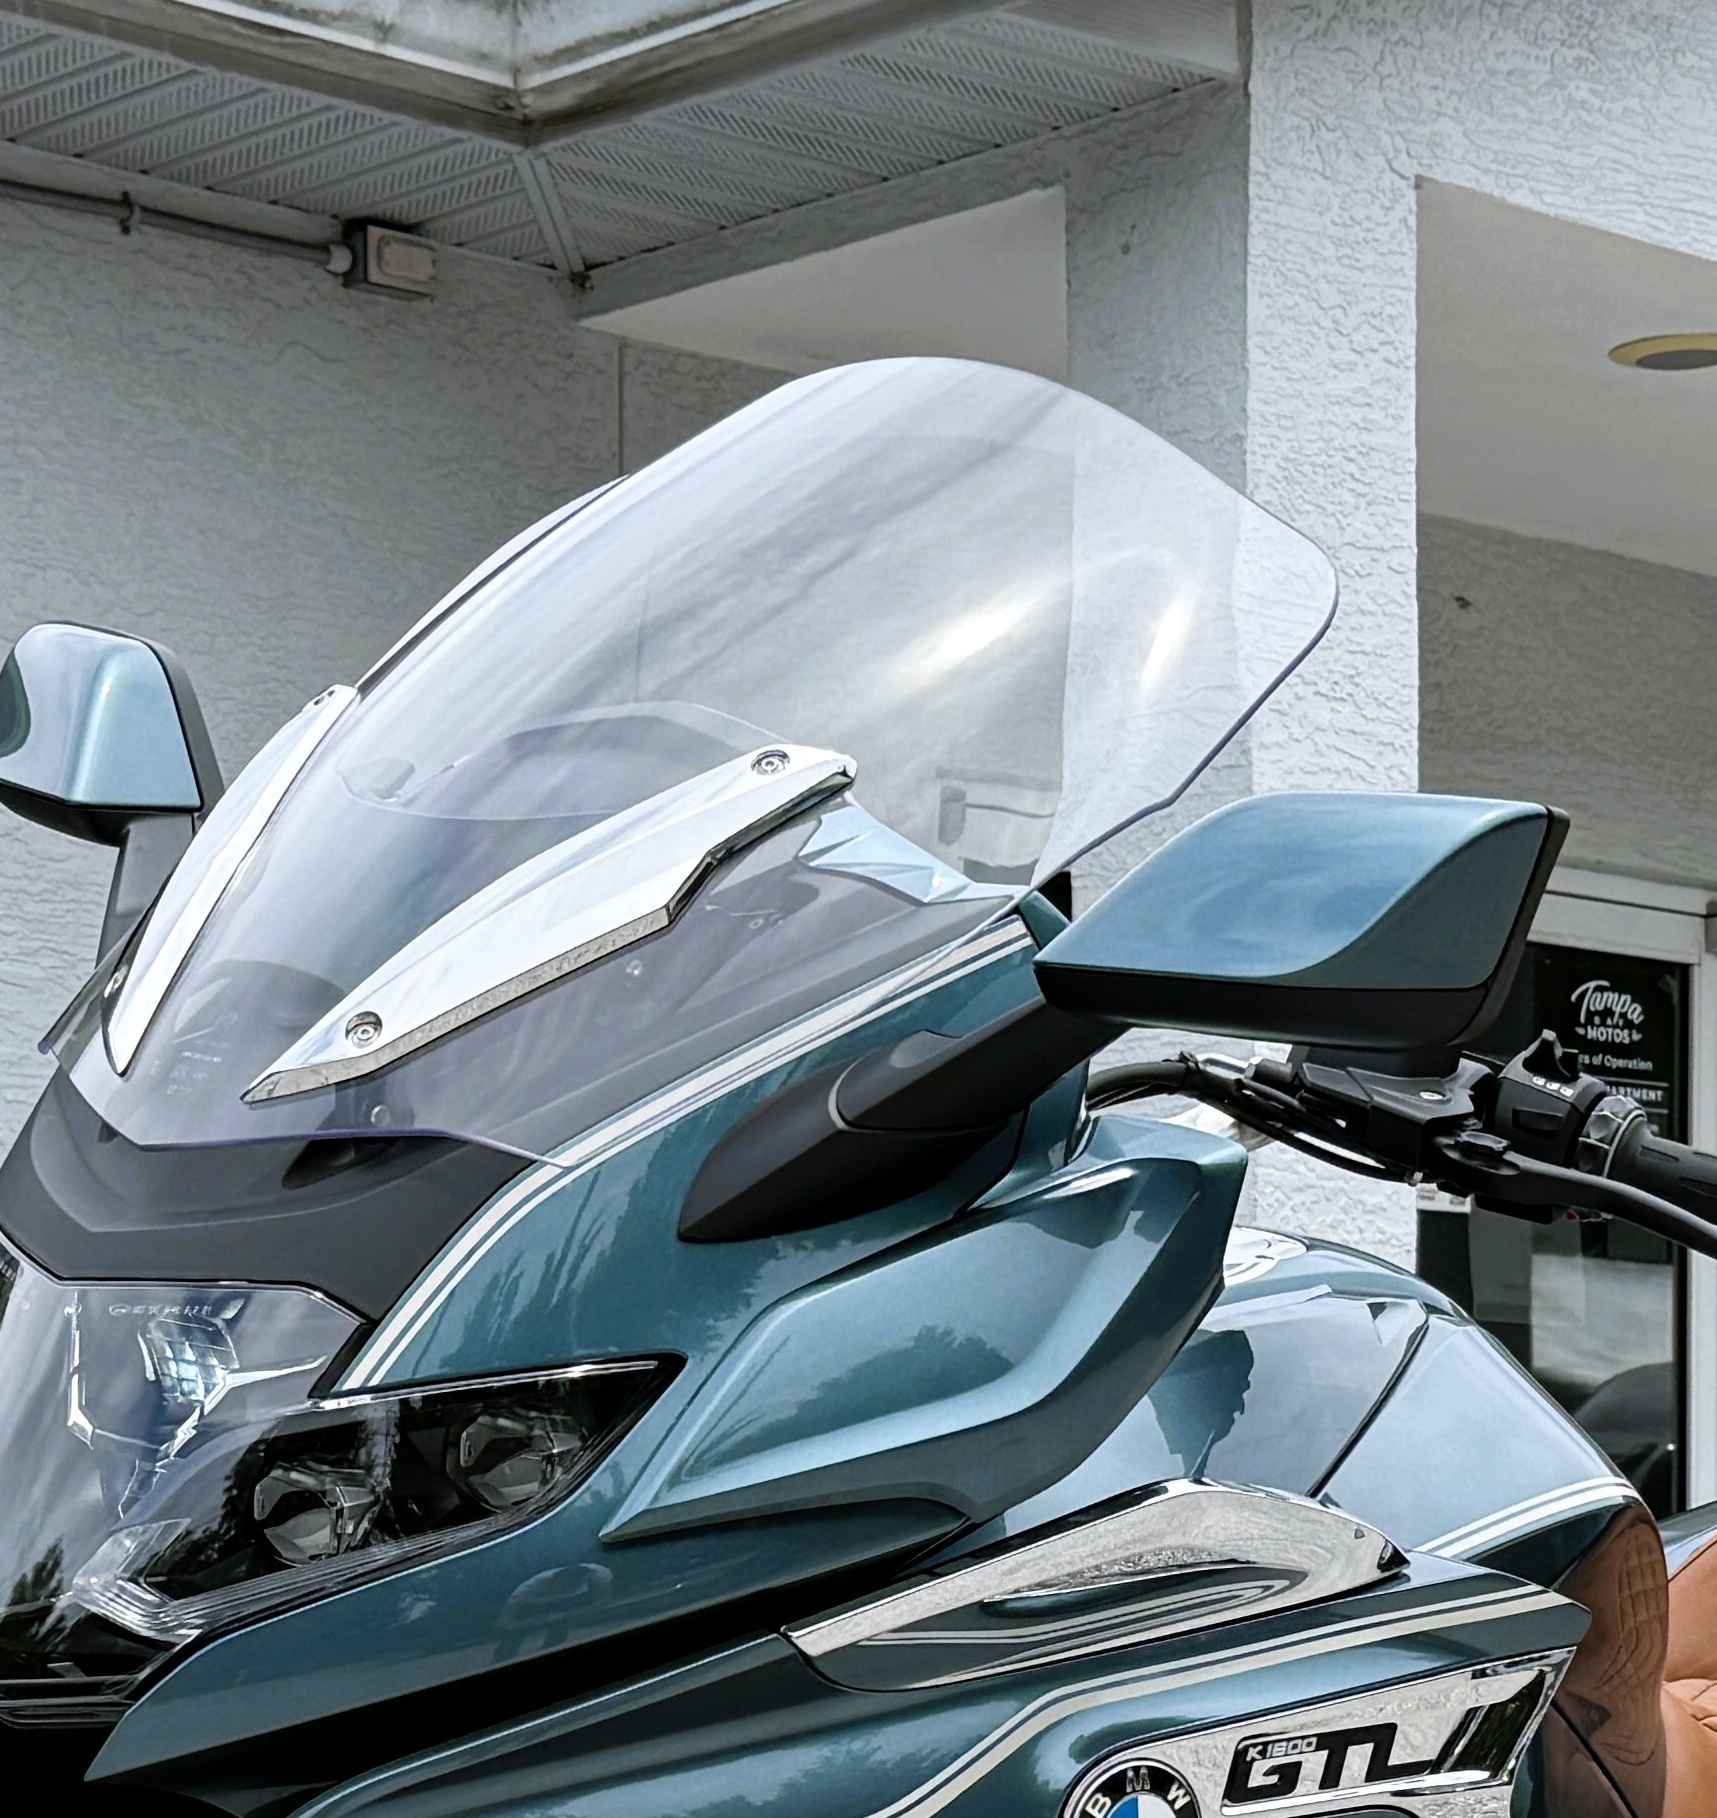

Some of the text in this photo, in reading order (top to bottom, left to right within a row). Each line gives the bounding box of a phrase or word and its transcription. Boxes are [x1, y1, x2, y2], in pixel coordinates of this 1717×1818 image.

[1571, 980, 1644, 1024] Tampa
[1587, 1025, 1630, 1044] MOTOS
[1222, 1721, 1436, 1803] GTL
